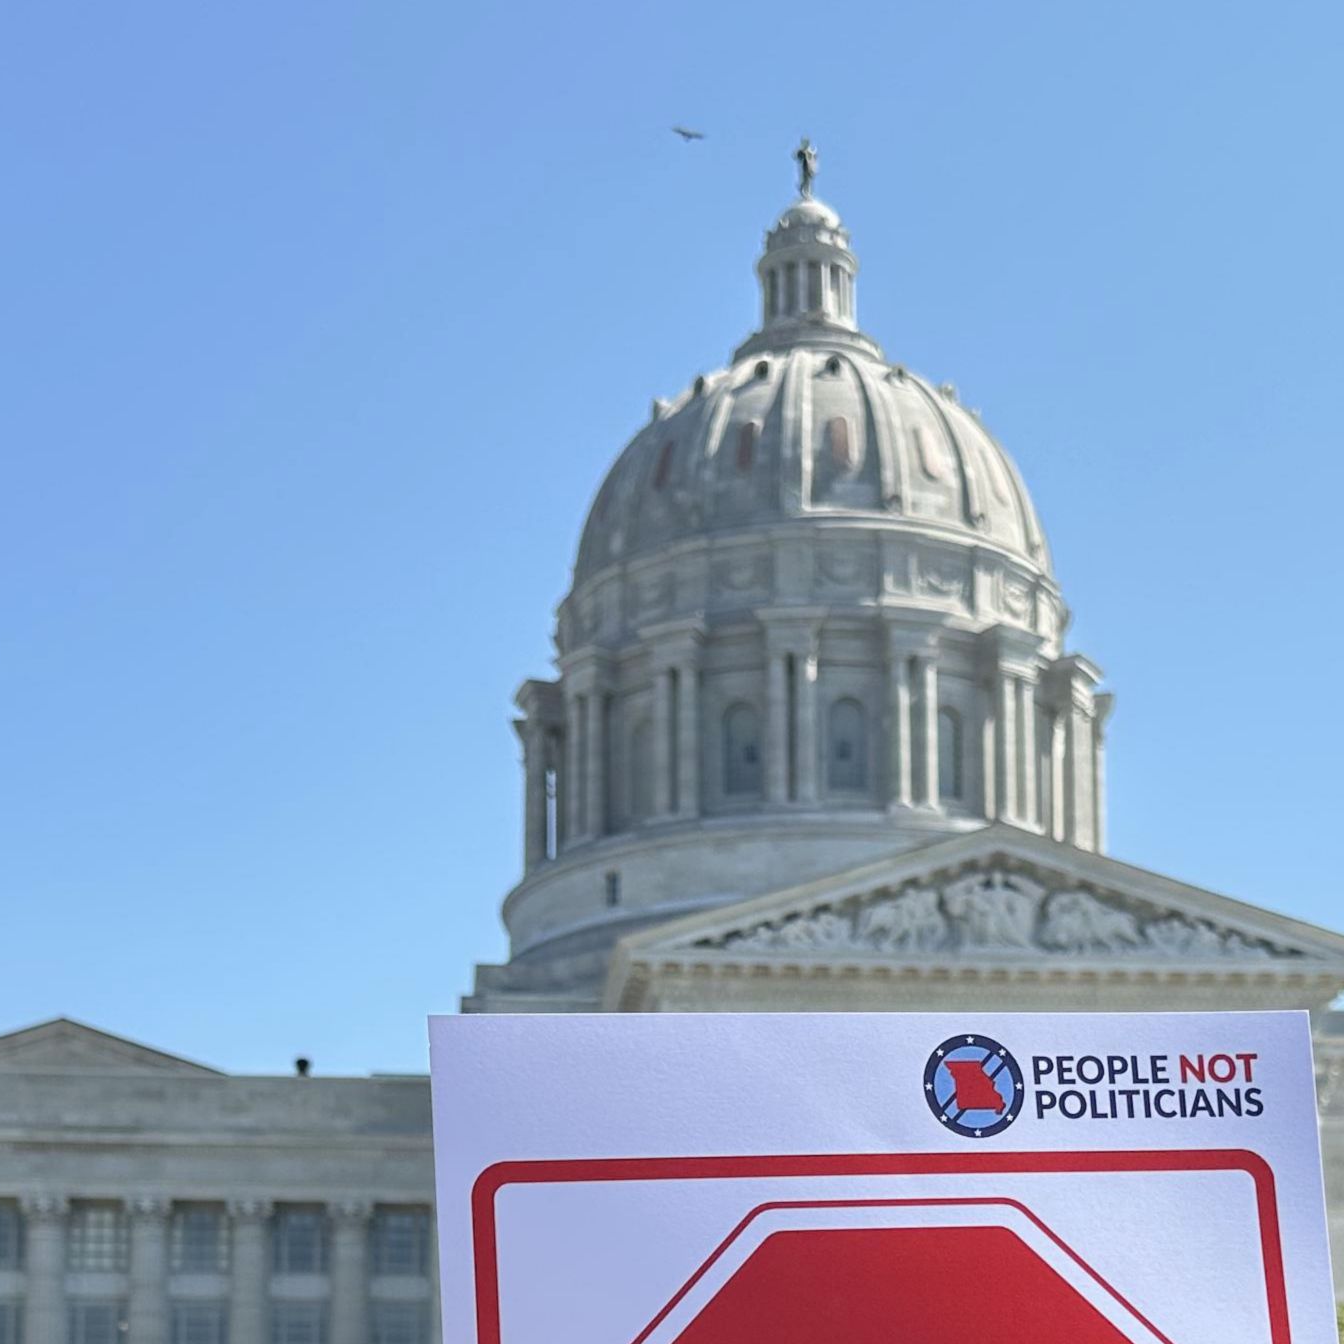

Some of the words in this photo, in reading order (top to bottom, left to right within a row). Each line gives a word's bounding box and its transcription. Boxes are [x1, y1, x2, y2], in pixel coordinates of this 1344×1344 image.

[1032, 1055, 1170, 1085] PEOPLE
[1179, 1053, 1258, 1083] NOT
[1035, 1088, 1264, 1119] POLITICIANS
